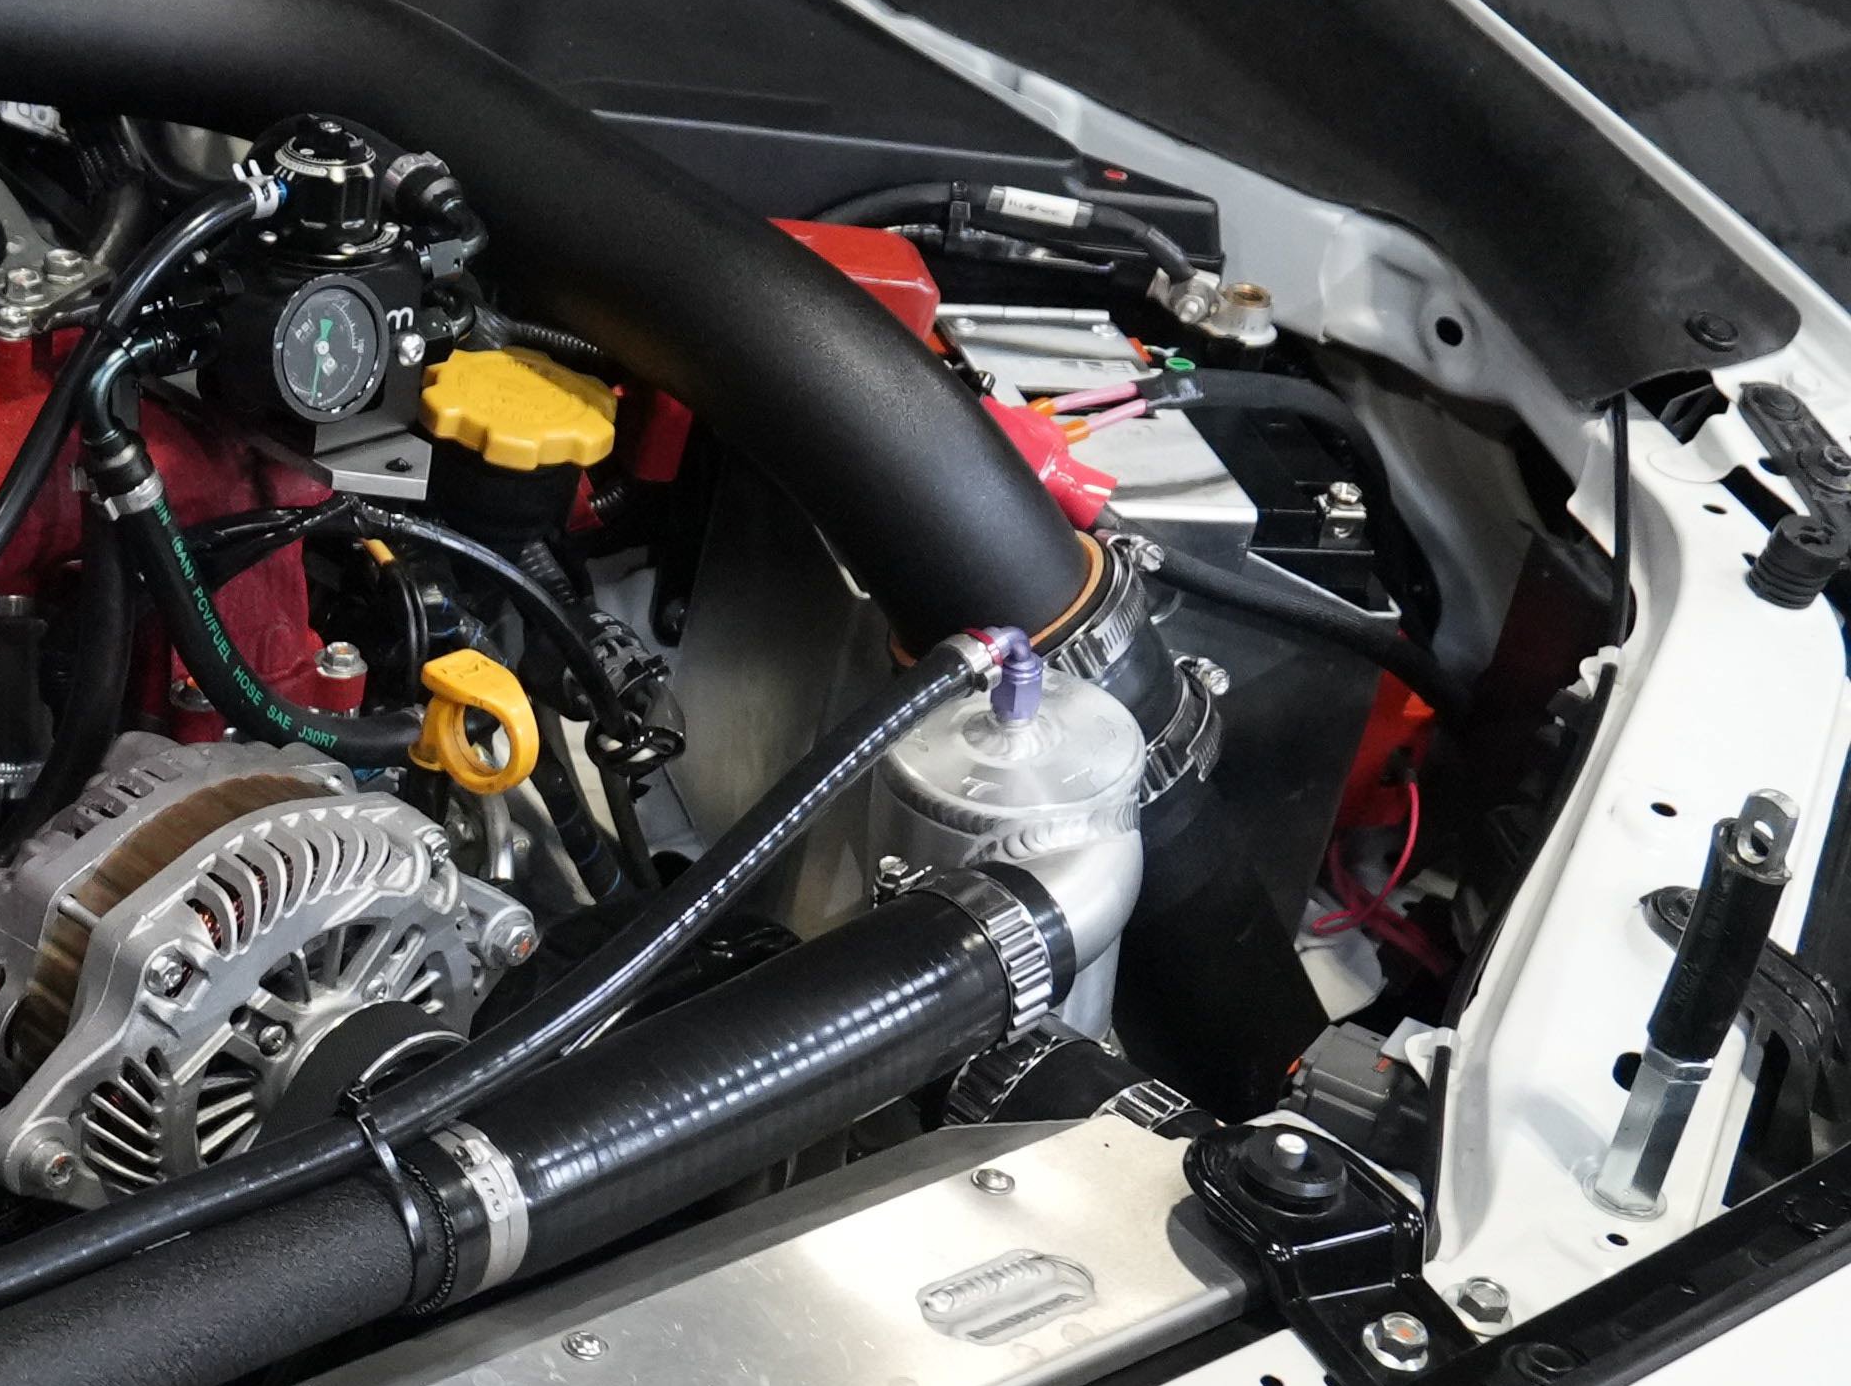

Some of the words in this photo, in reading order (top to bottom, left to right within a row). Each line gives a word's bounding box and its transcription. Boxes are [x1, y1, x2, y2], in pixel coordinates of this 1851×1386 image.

[192, 584, 232, 663] PCV/FUEL
[232, 664, 264, 706] HOSE
[266, 704, 293, 731] SAE
[298, 725, 339, 749] J30R7
